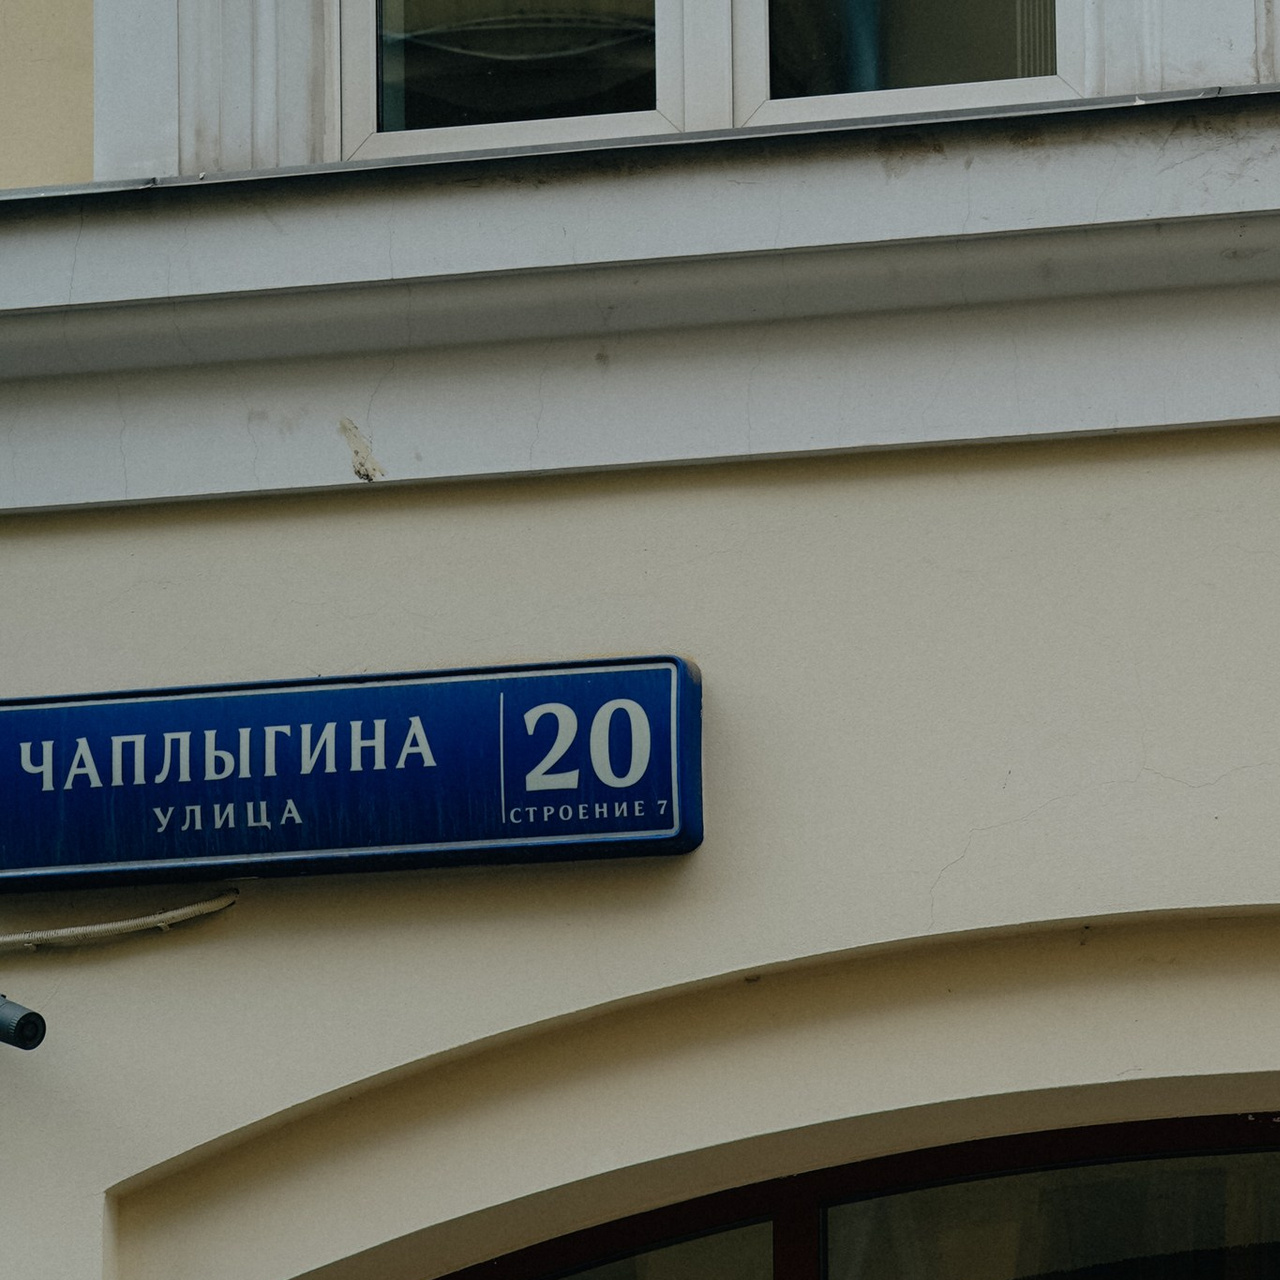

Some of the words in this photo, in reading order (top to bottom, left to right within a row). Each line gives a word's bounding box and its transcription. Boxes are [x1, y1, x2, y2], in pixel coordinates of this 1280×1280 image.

[19, 715, 437, 792] ЧАПЛЫГИНА
[523, 698, 651, 792] 20
[152, 799, 303, 833] УЛИЦА
[509, 800, 645, 824] СТРОЕНИЕ
[656, 799, 668, 816] 7
